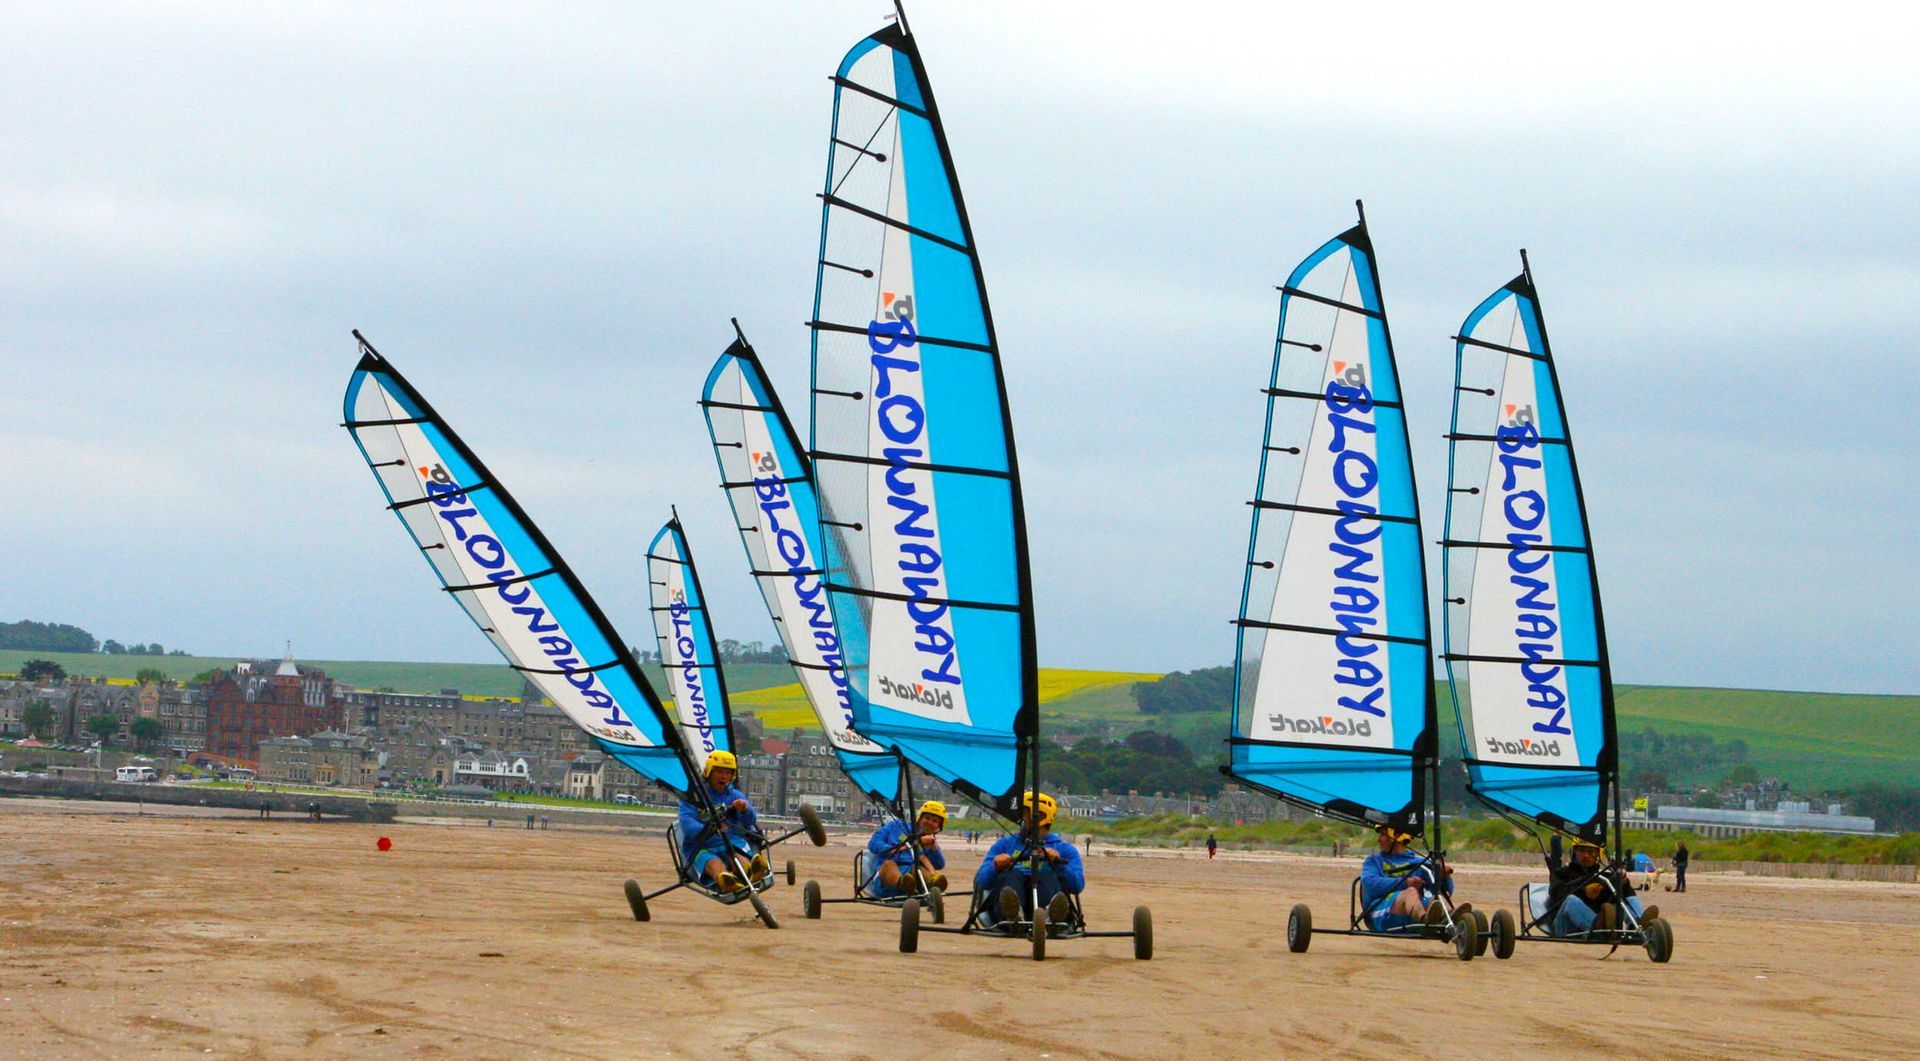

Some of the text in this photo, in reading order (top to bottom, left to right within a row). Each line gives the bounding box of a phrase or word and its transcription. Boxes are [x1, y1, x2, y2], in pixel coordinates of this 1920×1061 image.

[426, 481, 633, 727] BLOWNAWAY
[754, 474, 854, 724] BLOWNAW
[867, 316, 962, 685] BLOWNAWAY
[1325, 380, 1386, 718] BLOWNAWAY
[1496, 421, 1571, 736] BLOWNAWAY
[669, 600, 716, 753] BLOWNAWA
